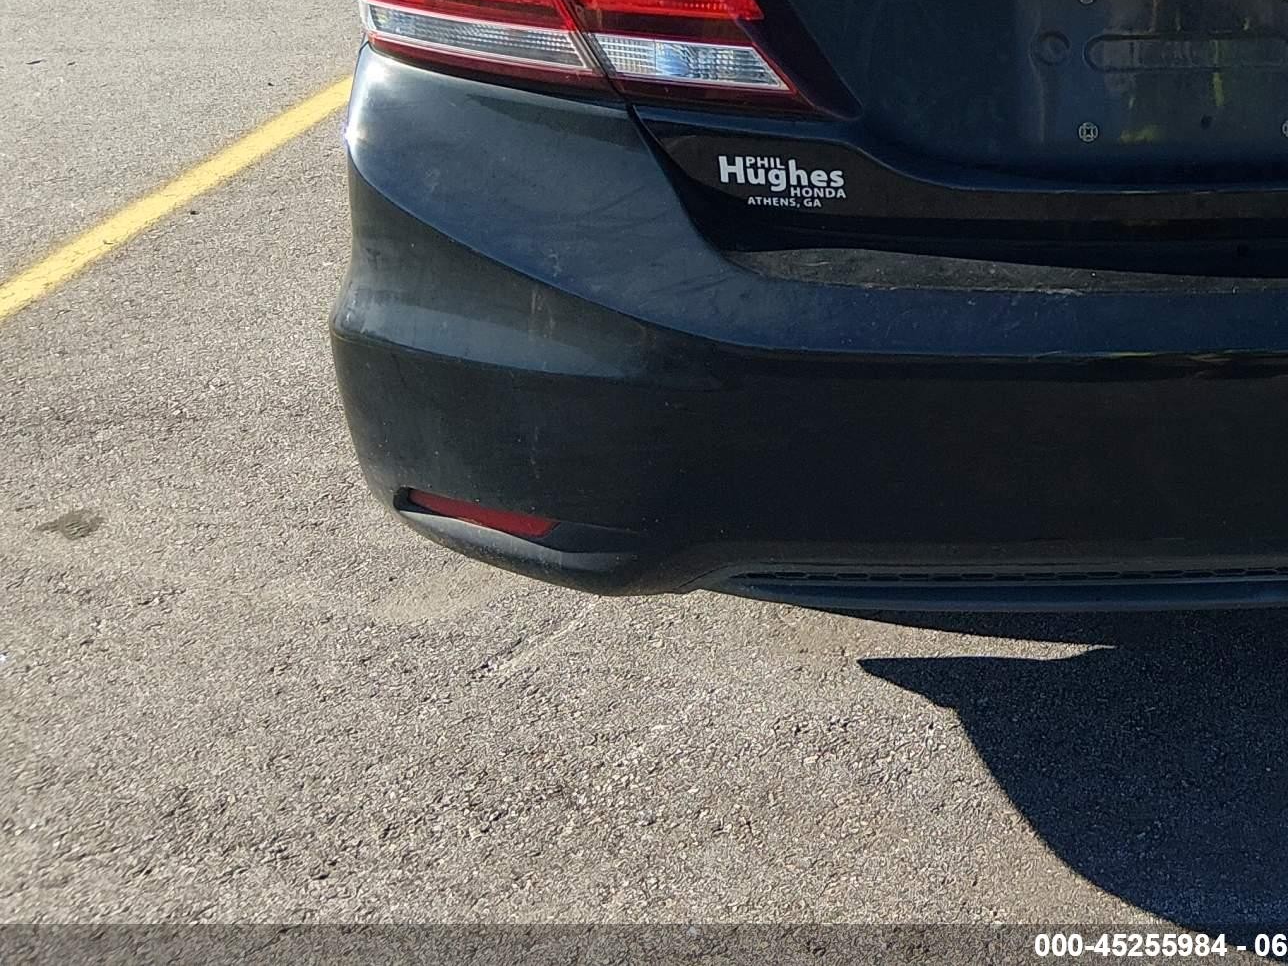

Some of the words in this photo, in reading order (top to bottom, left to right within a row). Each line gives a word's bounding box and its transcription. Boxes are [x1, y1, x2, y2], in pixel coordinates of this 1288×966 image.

[745, 156, 786, 169] PHIL
[718, 155, 845, 192] Hughes
[790, 187, 847, 199] HONDA
[747, 196, 800, 208] ATHENS,
[803, 198, 822, 208] GA
